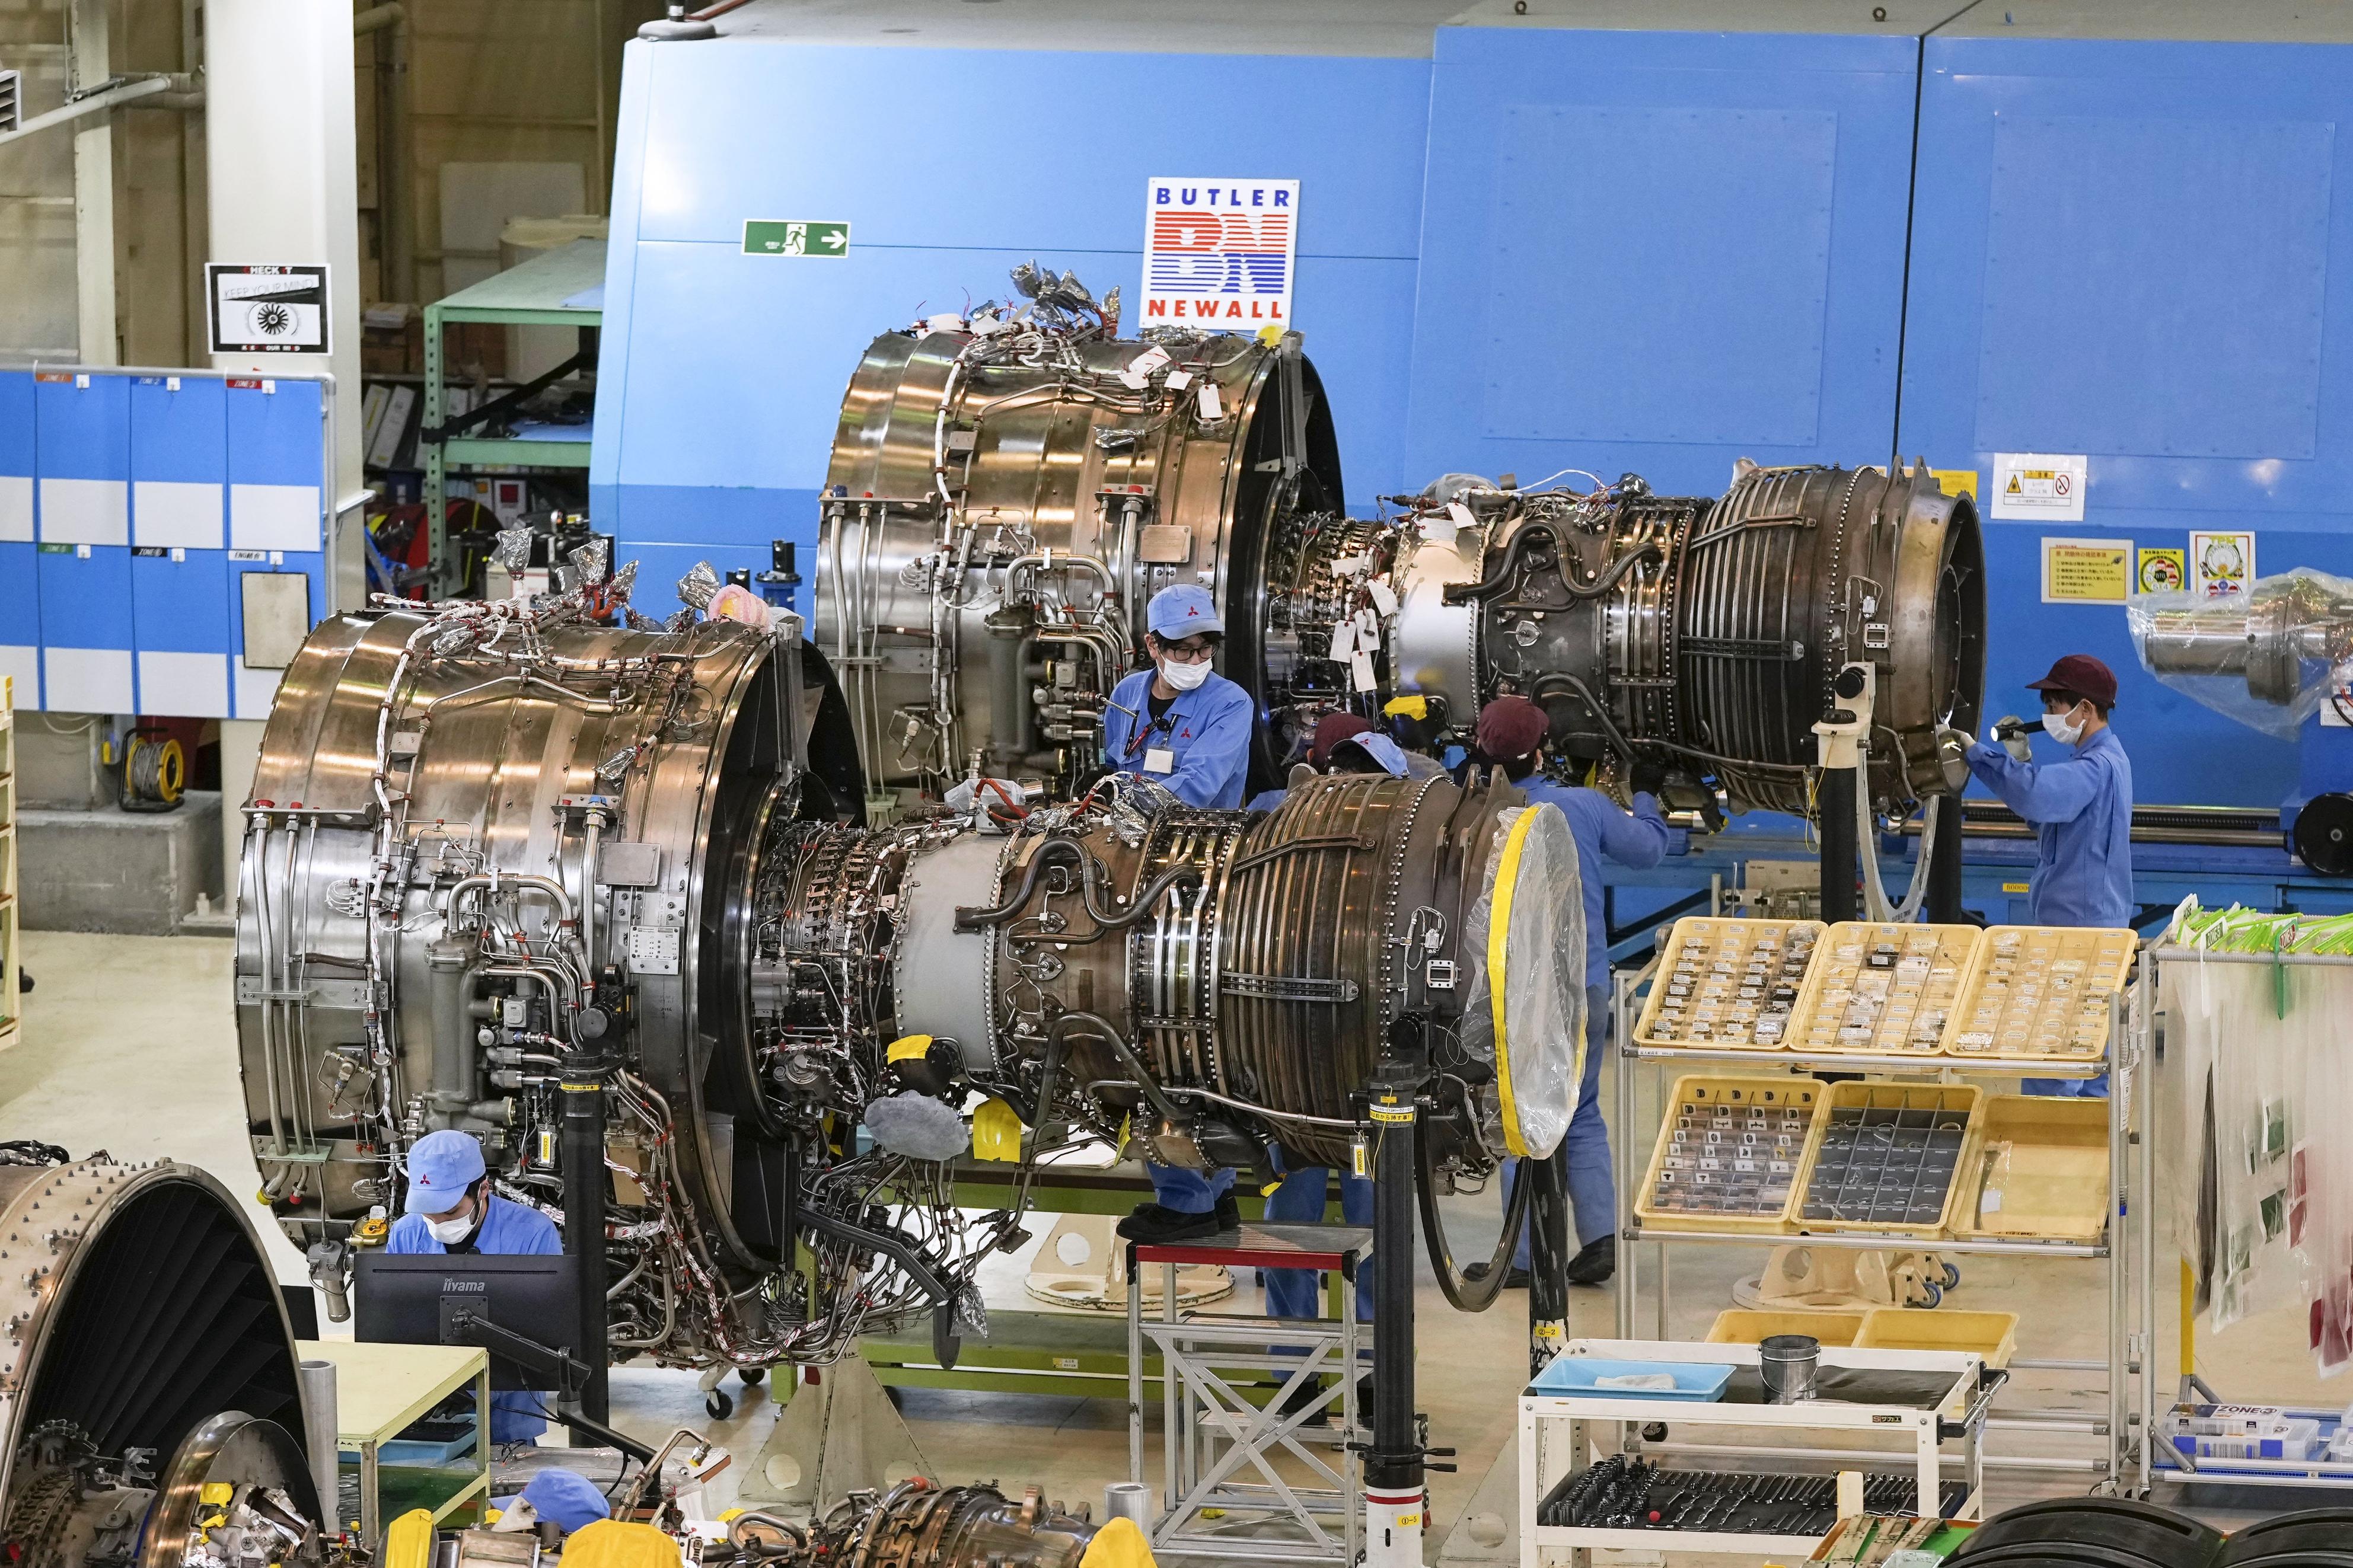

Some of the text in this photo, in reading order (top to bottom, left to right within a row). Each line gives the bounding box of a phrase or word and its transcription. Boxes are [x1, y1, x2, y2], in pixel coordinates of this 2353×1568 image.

[1156, 187, 1290, 207] BUTLER
[242, 266, 279, 274] CHECK
[1148, 299, 1283, 318] NEWALL
[442, 1278, 485, 1292] iiyama
